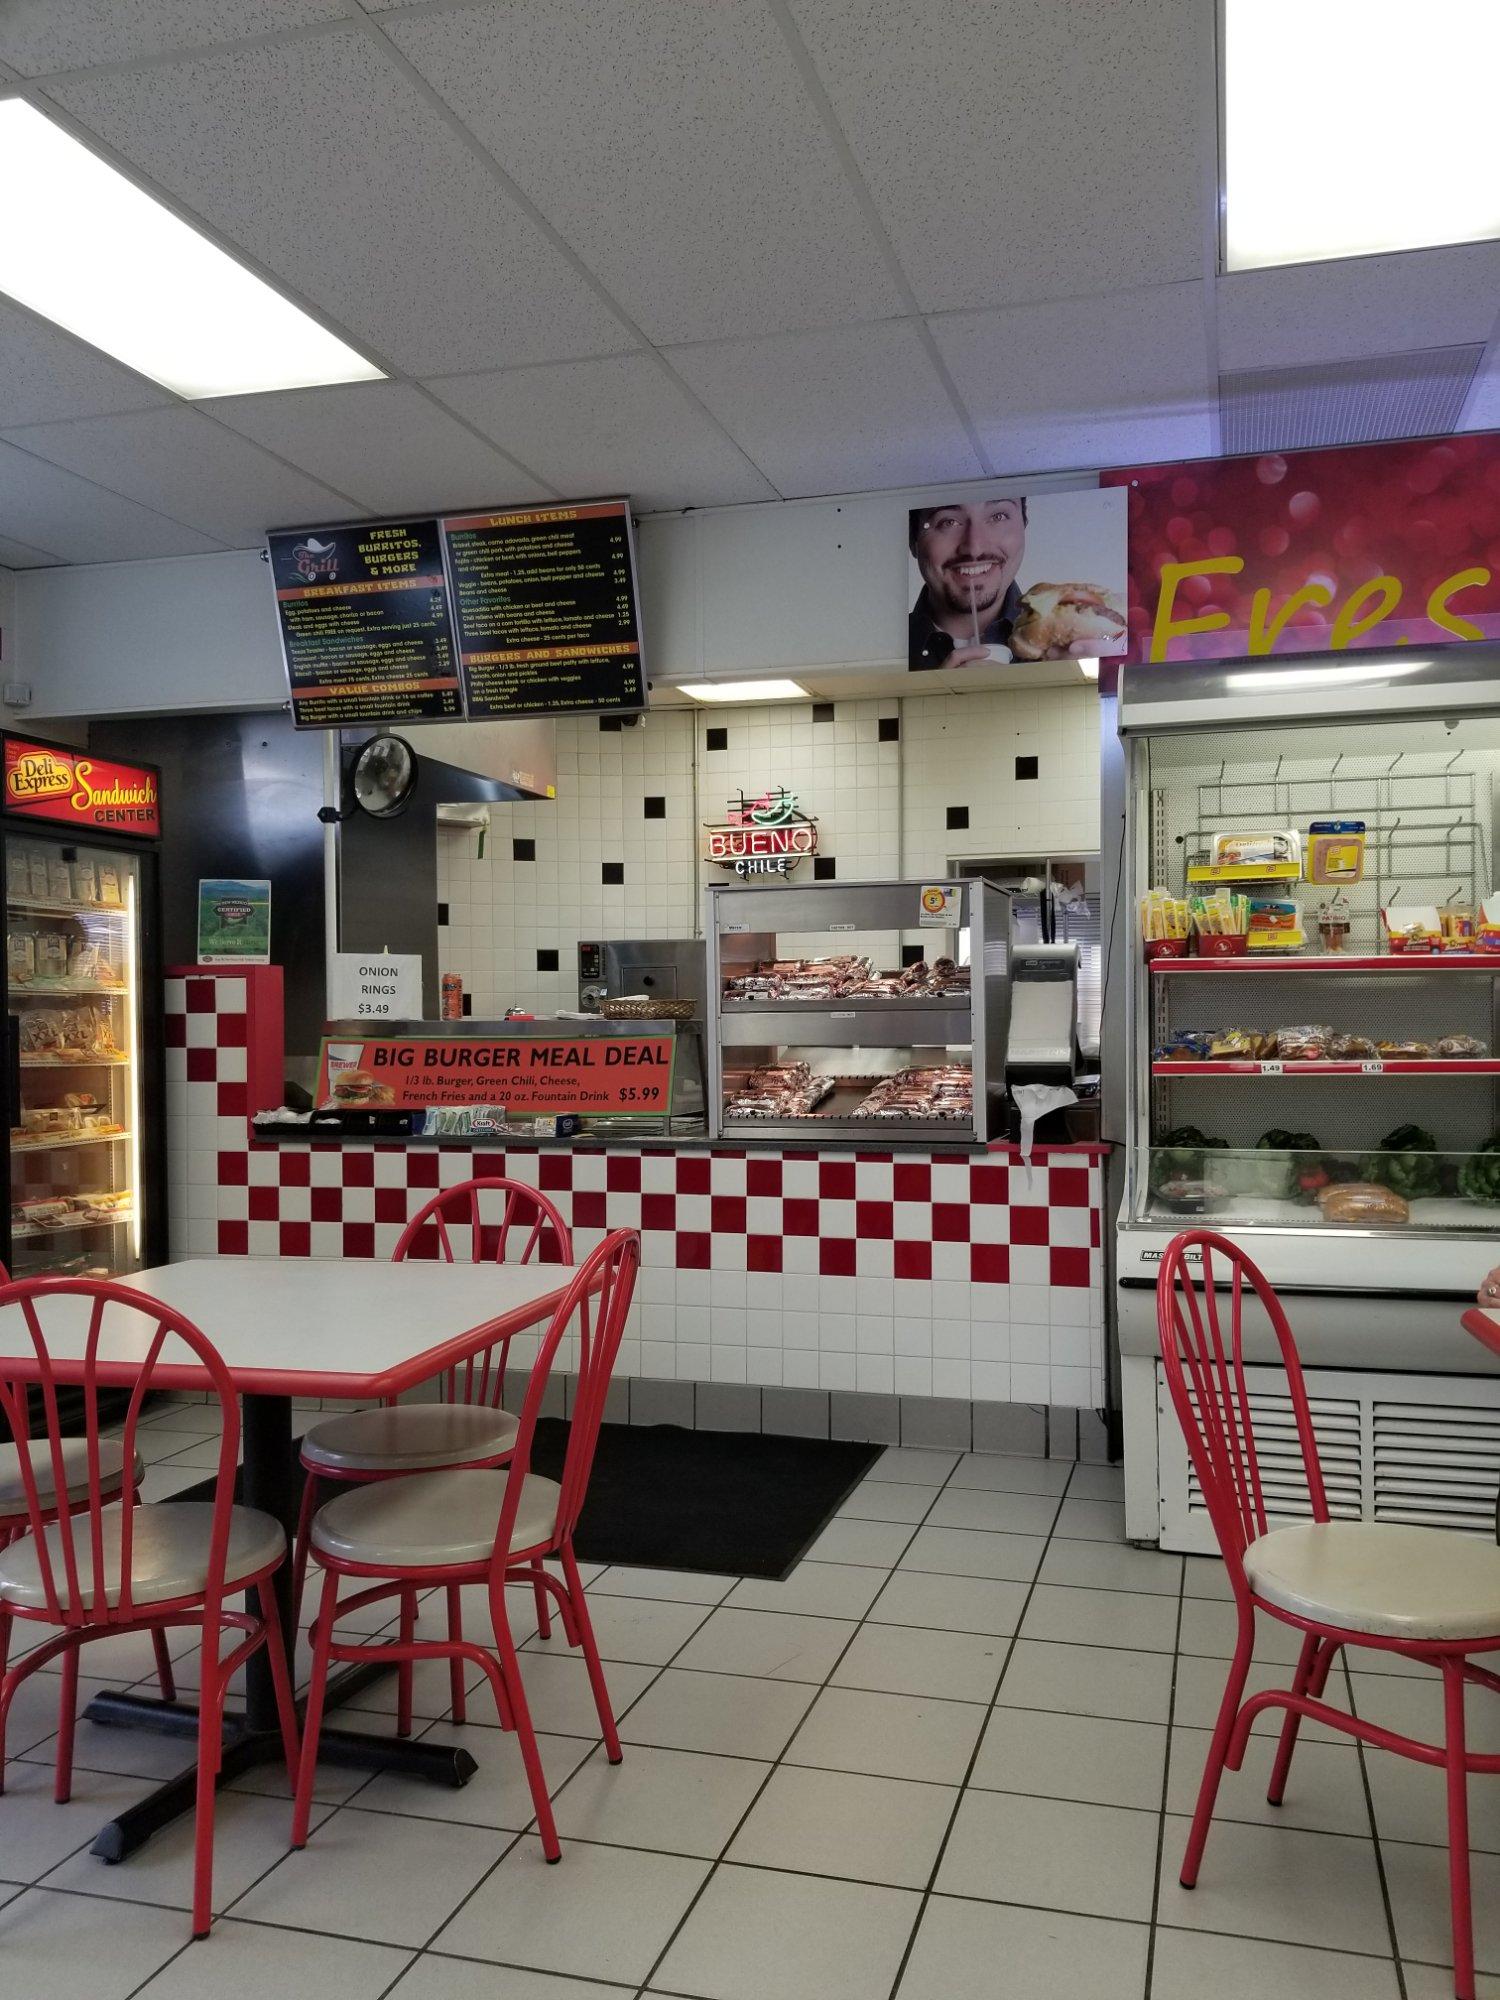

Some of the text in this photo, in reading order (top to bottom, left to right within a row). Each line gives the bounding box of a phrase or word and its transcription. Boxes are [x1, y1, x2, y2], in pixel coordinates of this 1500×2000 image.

[489, 510, 577, 526] LUNCH ITEMS
[369, 528, 406, 539] FRESH
[530, 535, 547, 543] green
[516, 543, 541, 551] potatoes
[609, 535, 622, 543] 4.99
[363, 551, 419, 564] BURGERS
[297, 555, 339, 574] Grill
[369, 563, 416, 575] & MORE
[303, 579, 416, 596] BREAKFAST ITEMS
[459, 595, 511, 605] Other Favorites
[288, 635, 363, 647] Breakfast Sandwiches
[469, 644, 629, 663] BURGERS AND SANDWICHES
[329, 681, 420, 694] VALUE COMBOS
[13, 758, 69, 793] Deli Express
[70, 761, 156, 811] Sandwich
[94, 809, 156, 822] CENTER
[709, 828, 812, 857] BUENO
[735, 858, 786, 874] CHILE
[359, 966, 399, 977] ONION
[361, 984, 396, 995] RINGS
[358, 1003, 389, 1015] $3.49
[33, 1029, 58, 1042] XXL
[64, 1030, 88, 1043] XXL
[373, 1045, 669, 1067] BIG BURGER MEAL DEAL
[1262, 1064, 1281, 1072] 1.49
[1363, 1063, 1382, 1071] 1.69
[405, 1075, 580, 1088] 1/3 lb. Burger, Green Chili, Cheese,
[402, 1090, 438, 1101] French
[441, 1090, 466, 1101] Fries
[468, 1090, 488, 1101] and
[499, 1090, 511, 1101] 20
[531, 1091, 578, 1101] Fountain
[580, 1090, 609, 1101] Drink
[618, 1086, 660, 1102] $5.99
[1143, 1252, 1203, 1261] MASBILT
